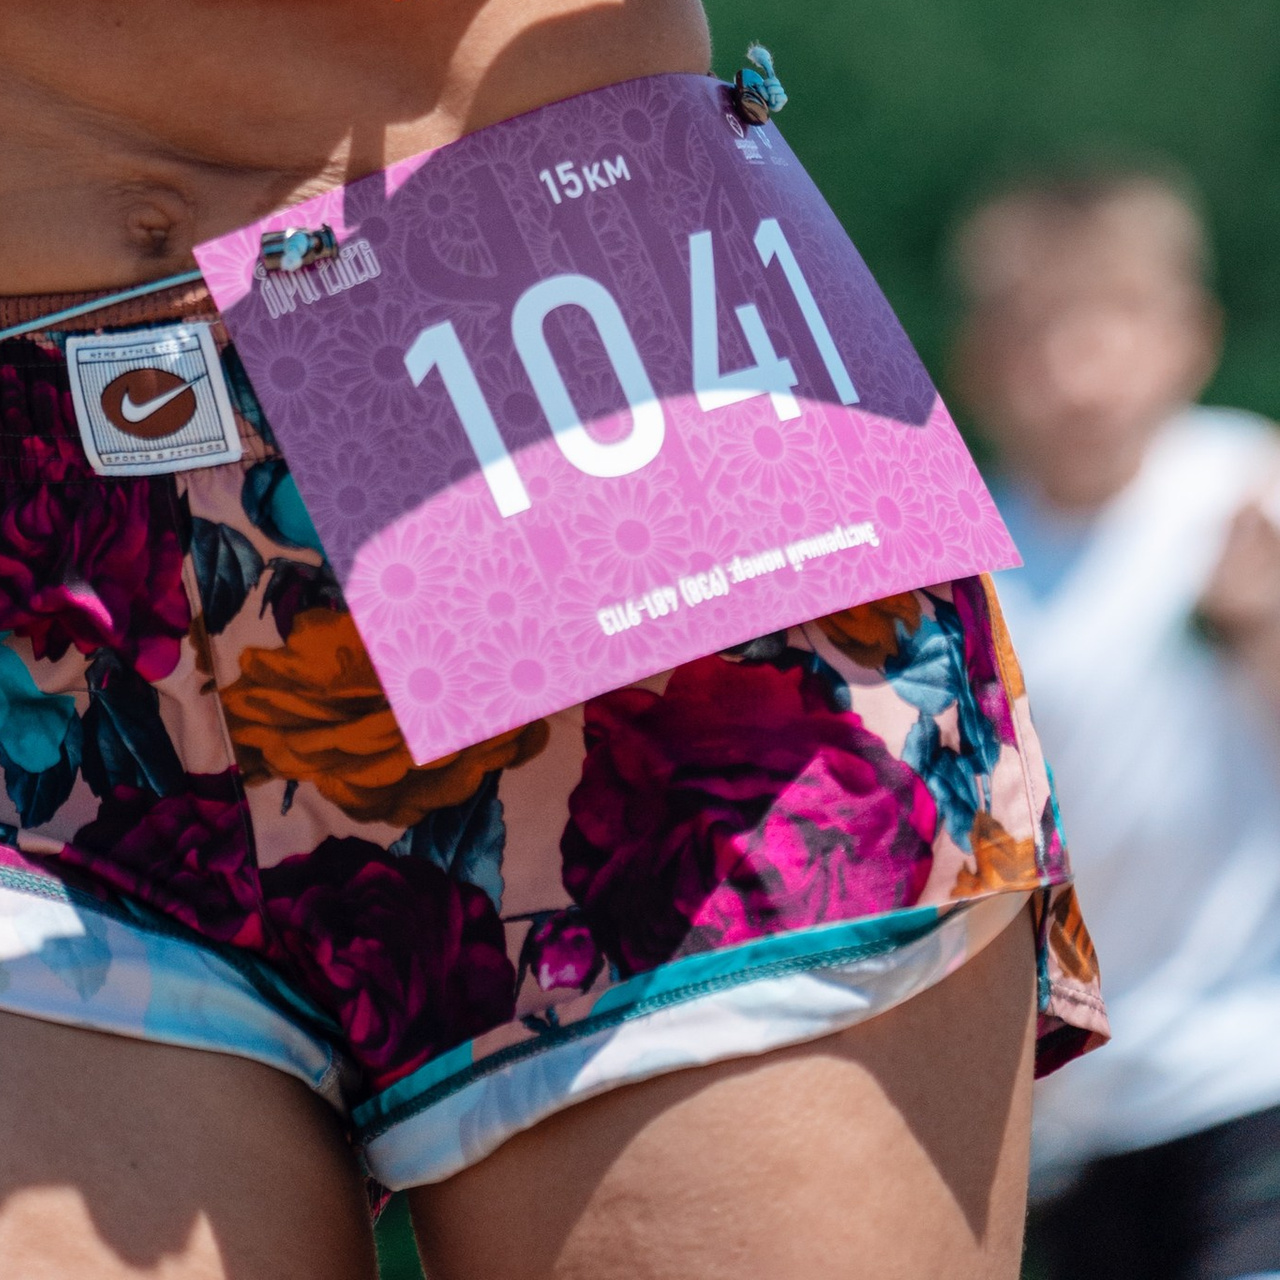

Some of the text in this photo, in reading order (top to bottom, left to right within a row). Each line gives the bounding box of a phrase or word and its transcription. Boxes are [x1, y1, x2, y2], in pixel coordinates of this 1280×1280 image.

[404, 218, 859, 519] 1041
[105, 454, 151, 463] SPORTS
[170, 443, 222, 457] FITNESS
[785, 521, 880, 573] Экстренный
[678, 565, 730, 608] (938)
